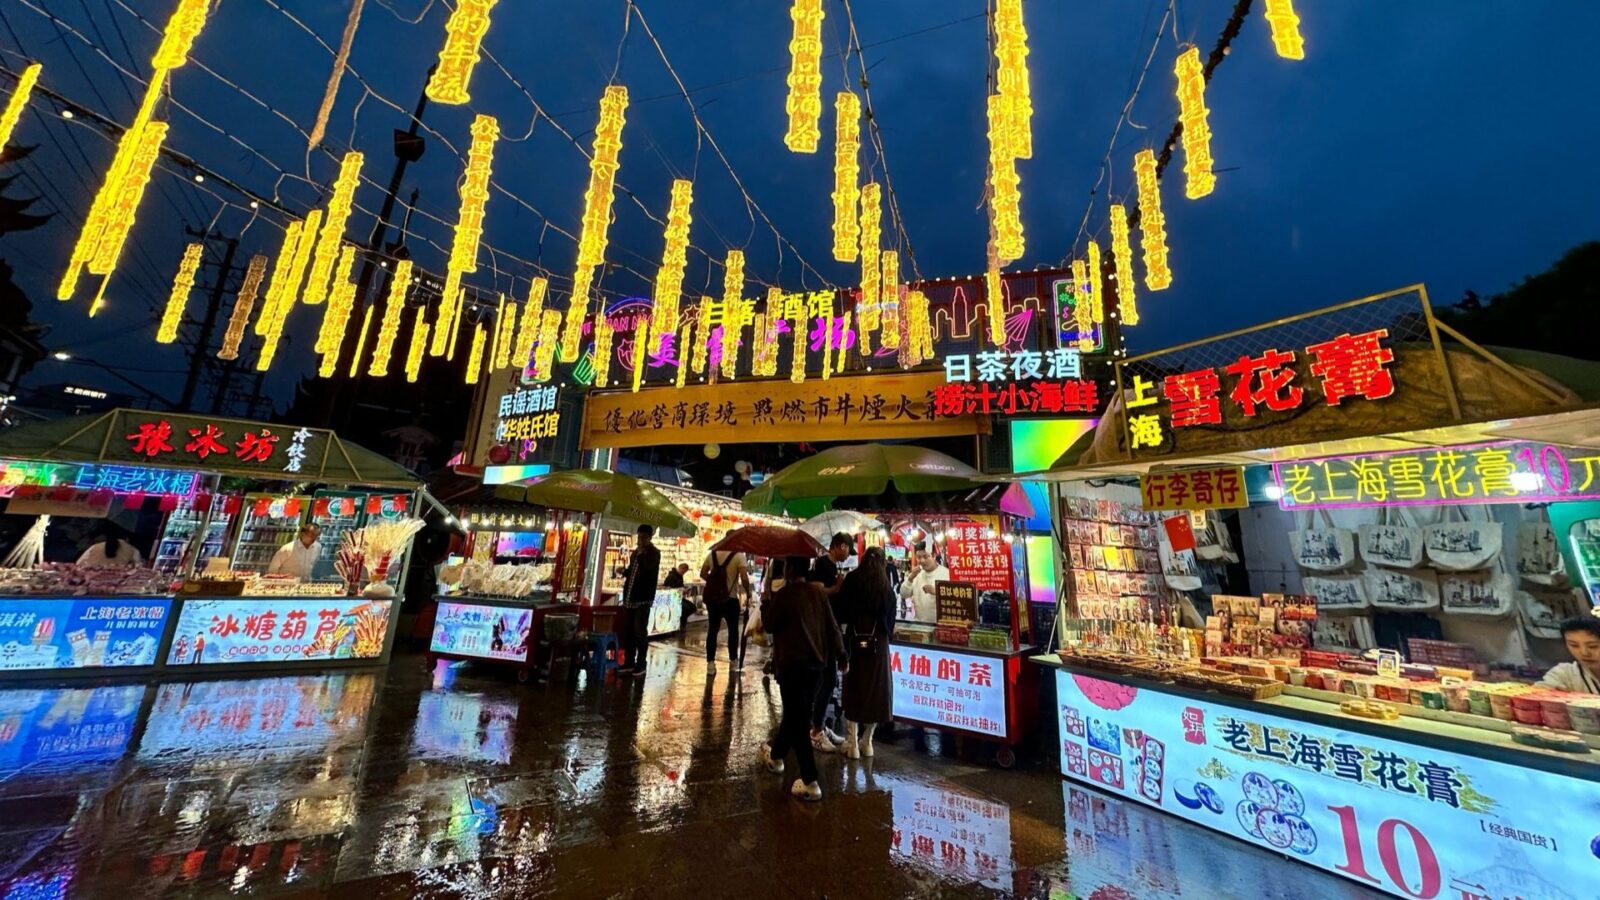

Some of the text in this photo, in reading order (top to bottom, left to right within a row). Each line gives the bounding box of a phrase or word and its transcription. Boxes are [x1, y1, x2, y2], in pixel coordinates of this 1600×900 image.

[943, 349, 1082, 383] 日茶夜酒
[1163, 329, 1396, 428] 雪花膏
[498, 386, 558, 417] 民谣酒馆
[935, 380, 1099, 414] 捞汁小海鲜
[1125, 375, 1165, 449] 上海
[75, 464, 194, 494] 上海老冰棍
[1145, 469, 1239, 507] 行李寄存
[958, 542, 1001, 555] 1元1张
[208, 608, 341, 641] 冰糖葫芦
[1220, 717, 1465, 809] 老上海雪花膏
[1326, 804, 1442, 900] 10
